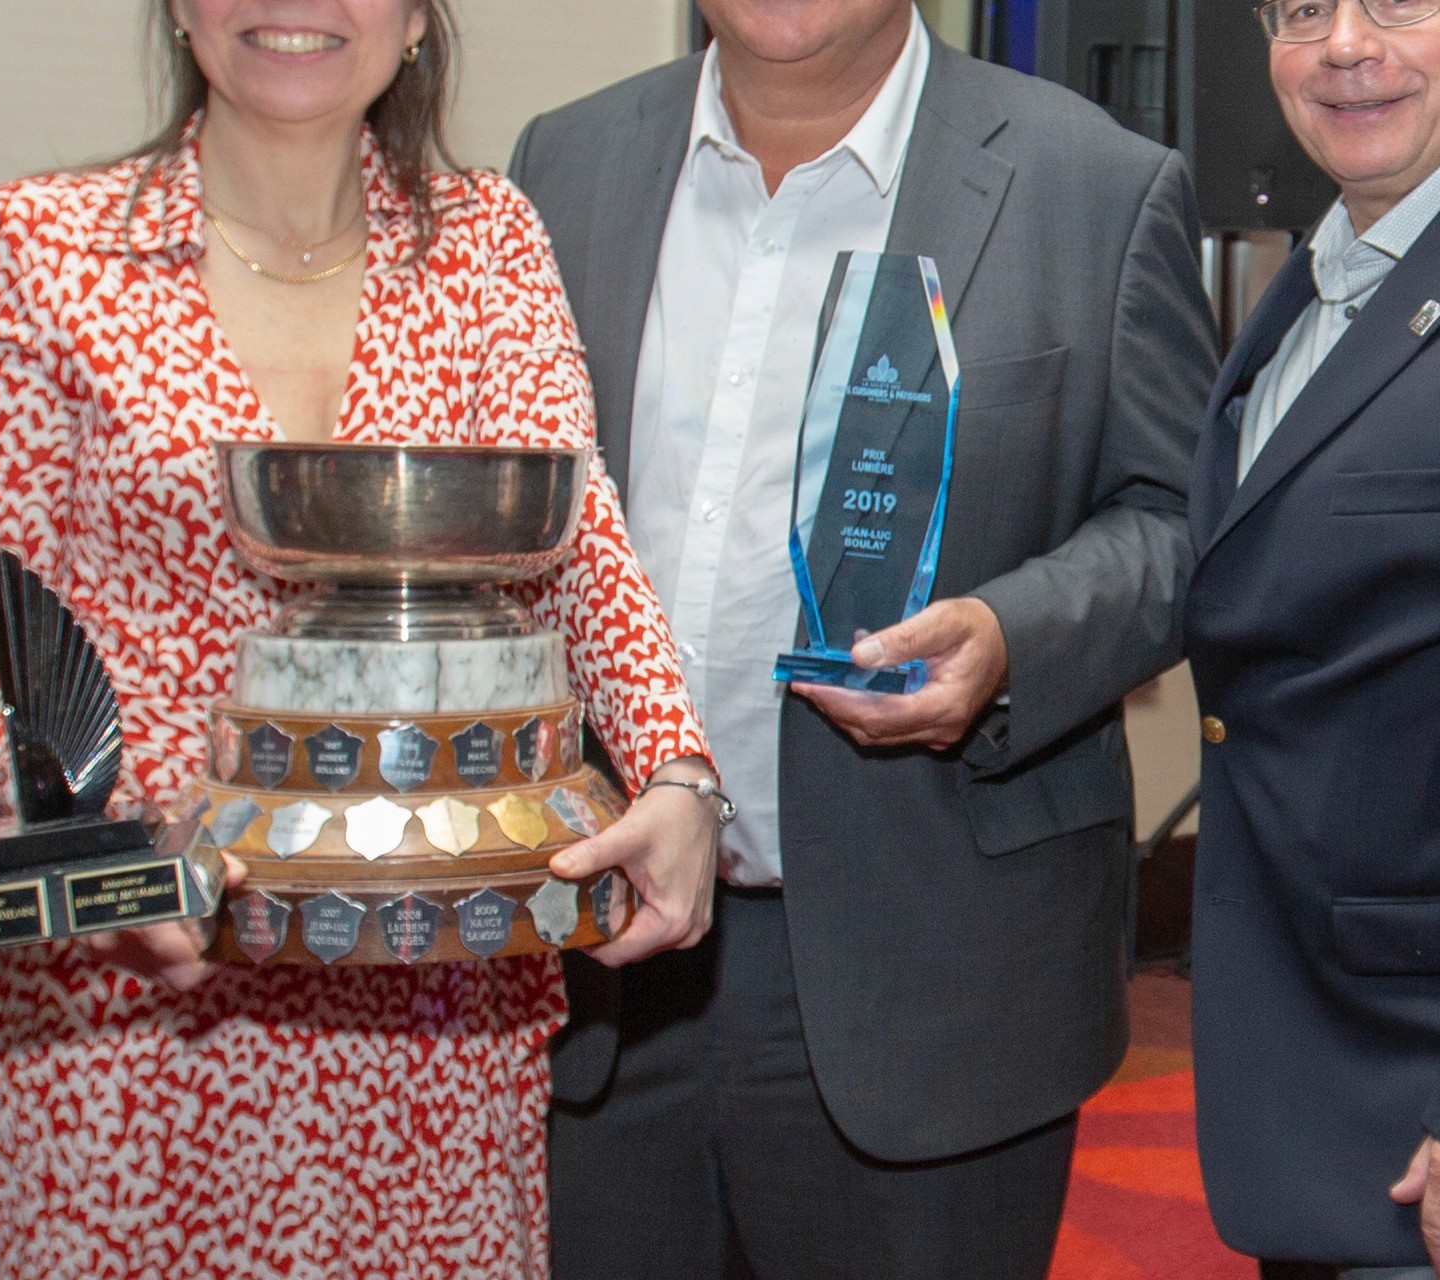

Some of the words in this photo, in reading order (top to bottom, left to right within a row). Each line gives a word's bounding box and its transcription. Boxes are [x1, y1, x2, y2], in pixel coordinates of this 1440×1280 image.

[863, 448, 886, 461] PRIX
[843, 488, 897, 513] 2019
[840, 526, 892, 540] JEAN-LUC
[844, 537, 887, 551] BOULAY
[396, 909, 424, 921] 2008
[474, 904, 500, 916] 2009
[386, 922, 431, 934] LAURENT
